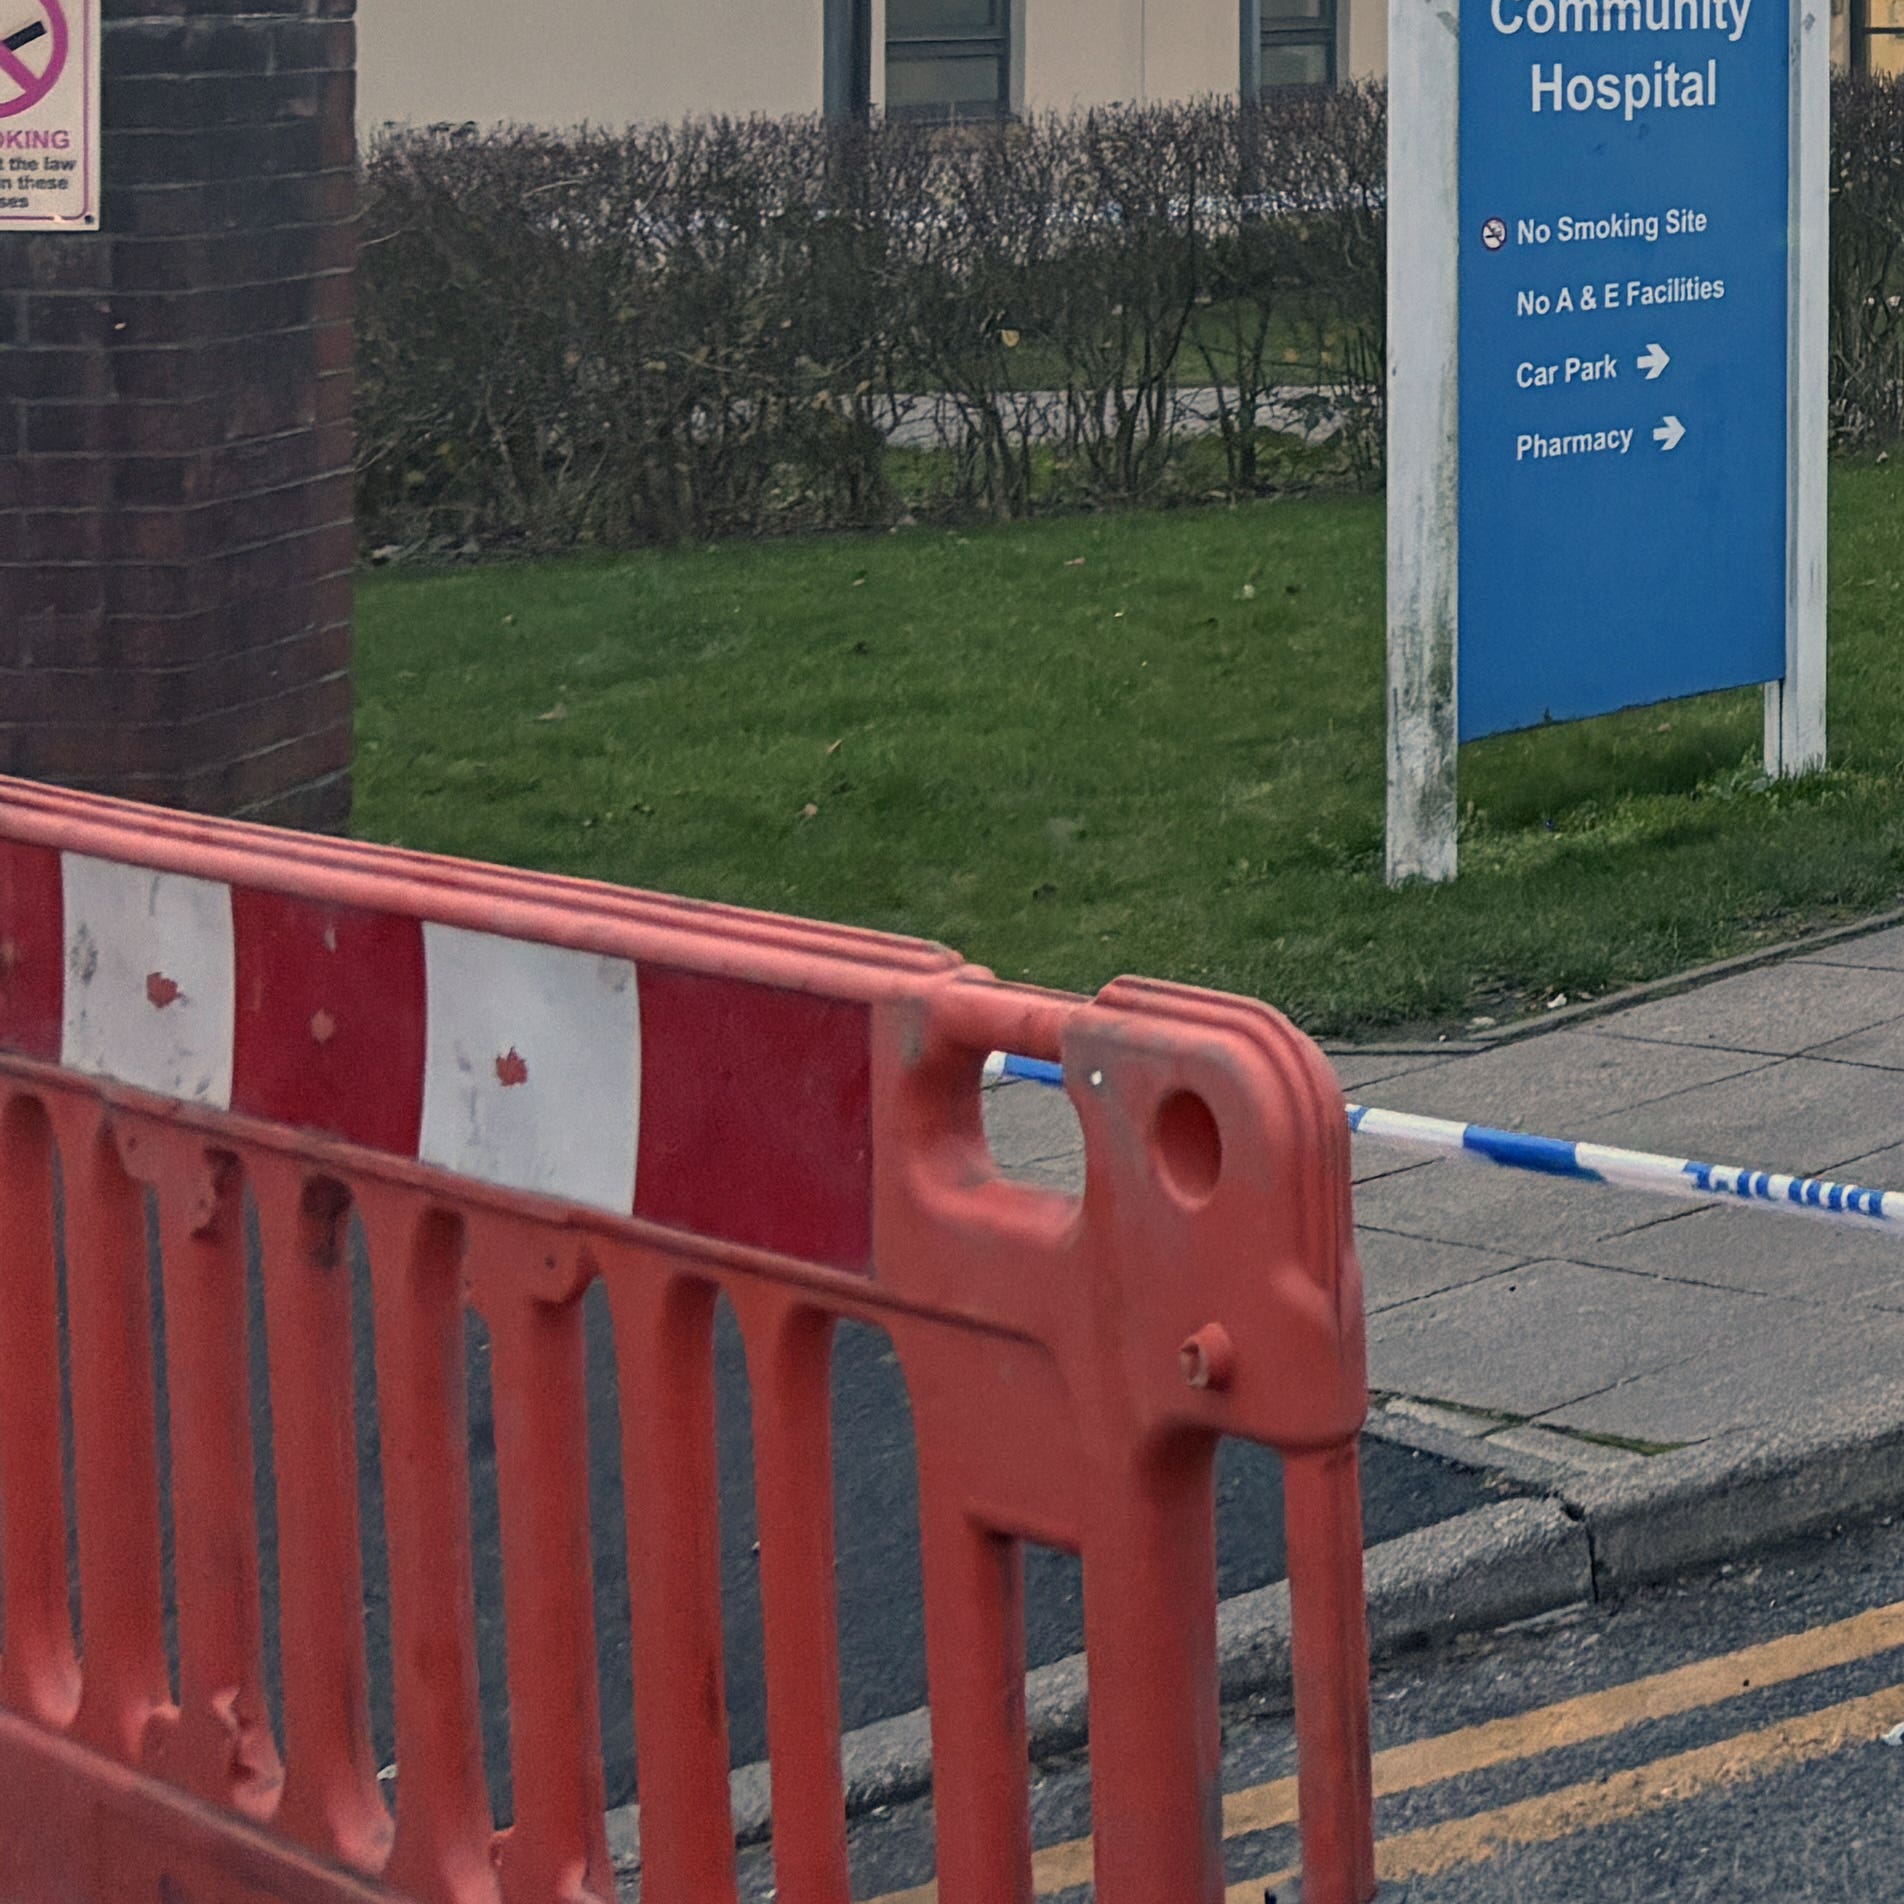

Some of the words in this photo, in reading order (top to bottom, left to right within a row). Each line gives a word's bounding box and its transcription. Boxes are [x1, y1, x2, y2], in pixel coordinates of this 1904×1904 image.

[1530, 59, 1717, 121] Hospital
[0, 129, 71, 149] KING
[9, 157, 39, 172] the
[43, 156, 77, 172] law
[18, 176, 69, 191] these
[1516, 218, 1551, 245] No
[1557, 212, 1659, 242] Smoking
[1665, 208, 1708, 234] Site
[1516, 290, 1550, 317] No
[1555, 287, 1575, 313] A
[1580, 285, 1598, 311] &
[1604, 283, 1620, 309] E
[1626, 276, 1725, 307] Facilities
[1516, 360, 1558, 388] Car
[1564, 353, 1618, 385] Park
[1516, 425, 1634, 461] Pharmacy
